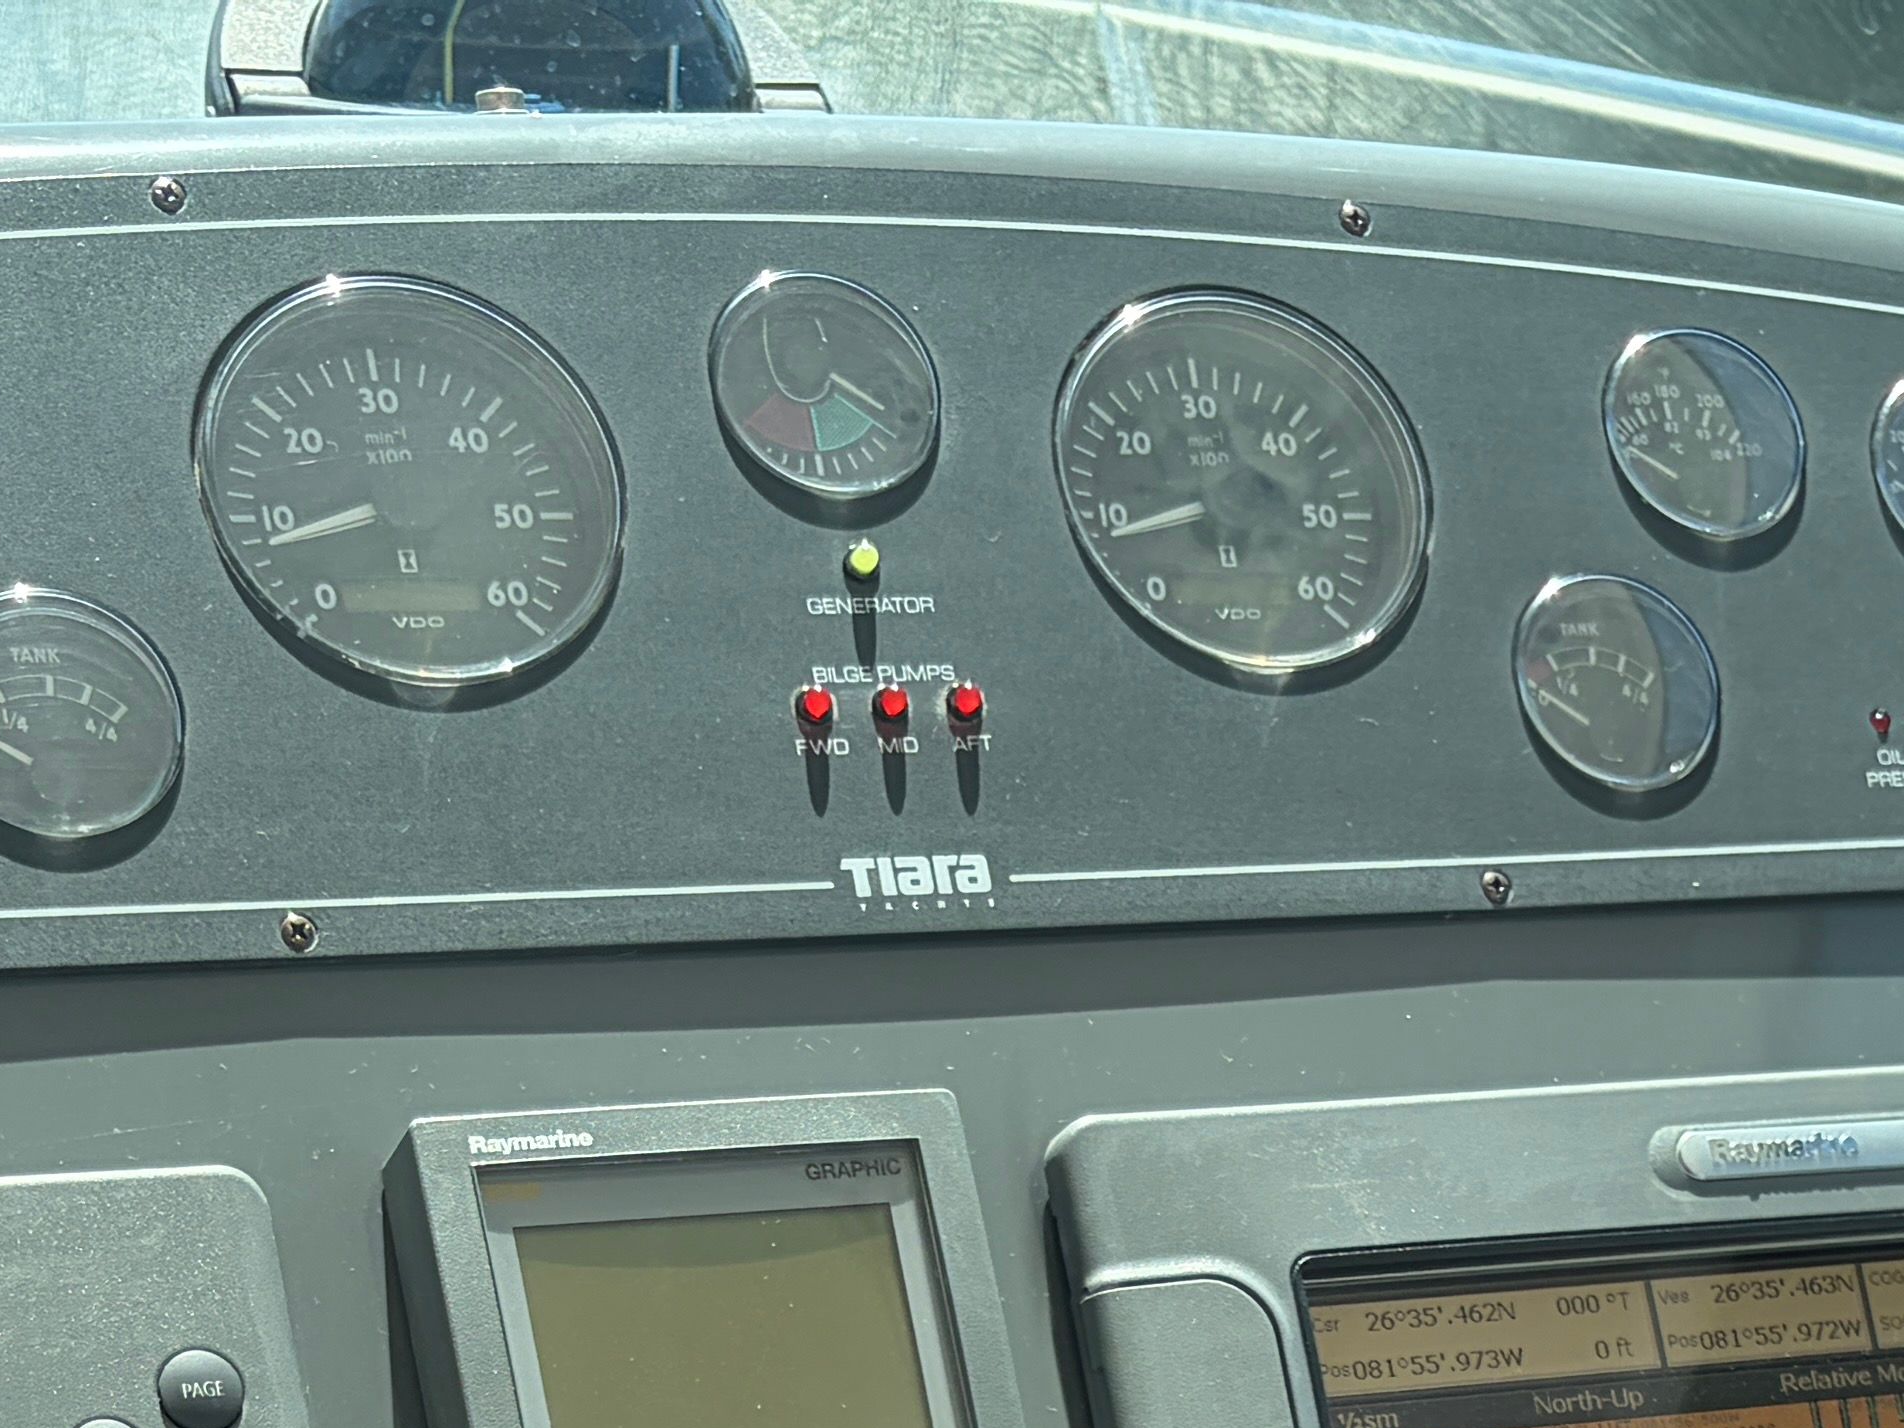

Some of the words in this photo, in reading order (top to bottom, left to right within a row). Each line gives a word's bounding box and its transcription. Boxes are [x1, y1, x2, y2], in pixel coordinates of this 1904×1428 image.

[358, 388, 399, 414] 30
[1183, 396, 1217, 419] 30
[283, 428, 323, 453] 20
[449, 428, 488, 453] 40
[1116, 432, 1151, 455] 20
[1262, 433, 1297, 456] 40
[262, 506, 294, 531] 10
[494, 504, 533, 528] 50
[1099, 504, 1128, 527] 10
[1302, 505, 1337, 528] 50
[487, 581, 528, 606] 60
[1298, 577, 1334, 600] 60
[806, 597, 935, 615] GENERATOR
[1215, 608, 1261, 619] VDO
[392, 616, 445, 628] VDO
[9, 647, 61, 664] TANK
[813, 667, 871, 684] BILGE
[877, 665, 955, 682] PUMPS
[795, 737, 849, 755] FWD
[878, 736, 918, 754] MID
[951, 734, 991, 751] AFT
[468, 1130, 594, 1155] Raymarine
[804, 1158, 902, 1181] GRAPHIC
[181, 1380, 225, 1398] PAGE
[1779, 1364, 1872, 1393] Relative
[1534, 1389, 1644, 1417] North-Up
